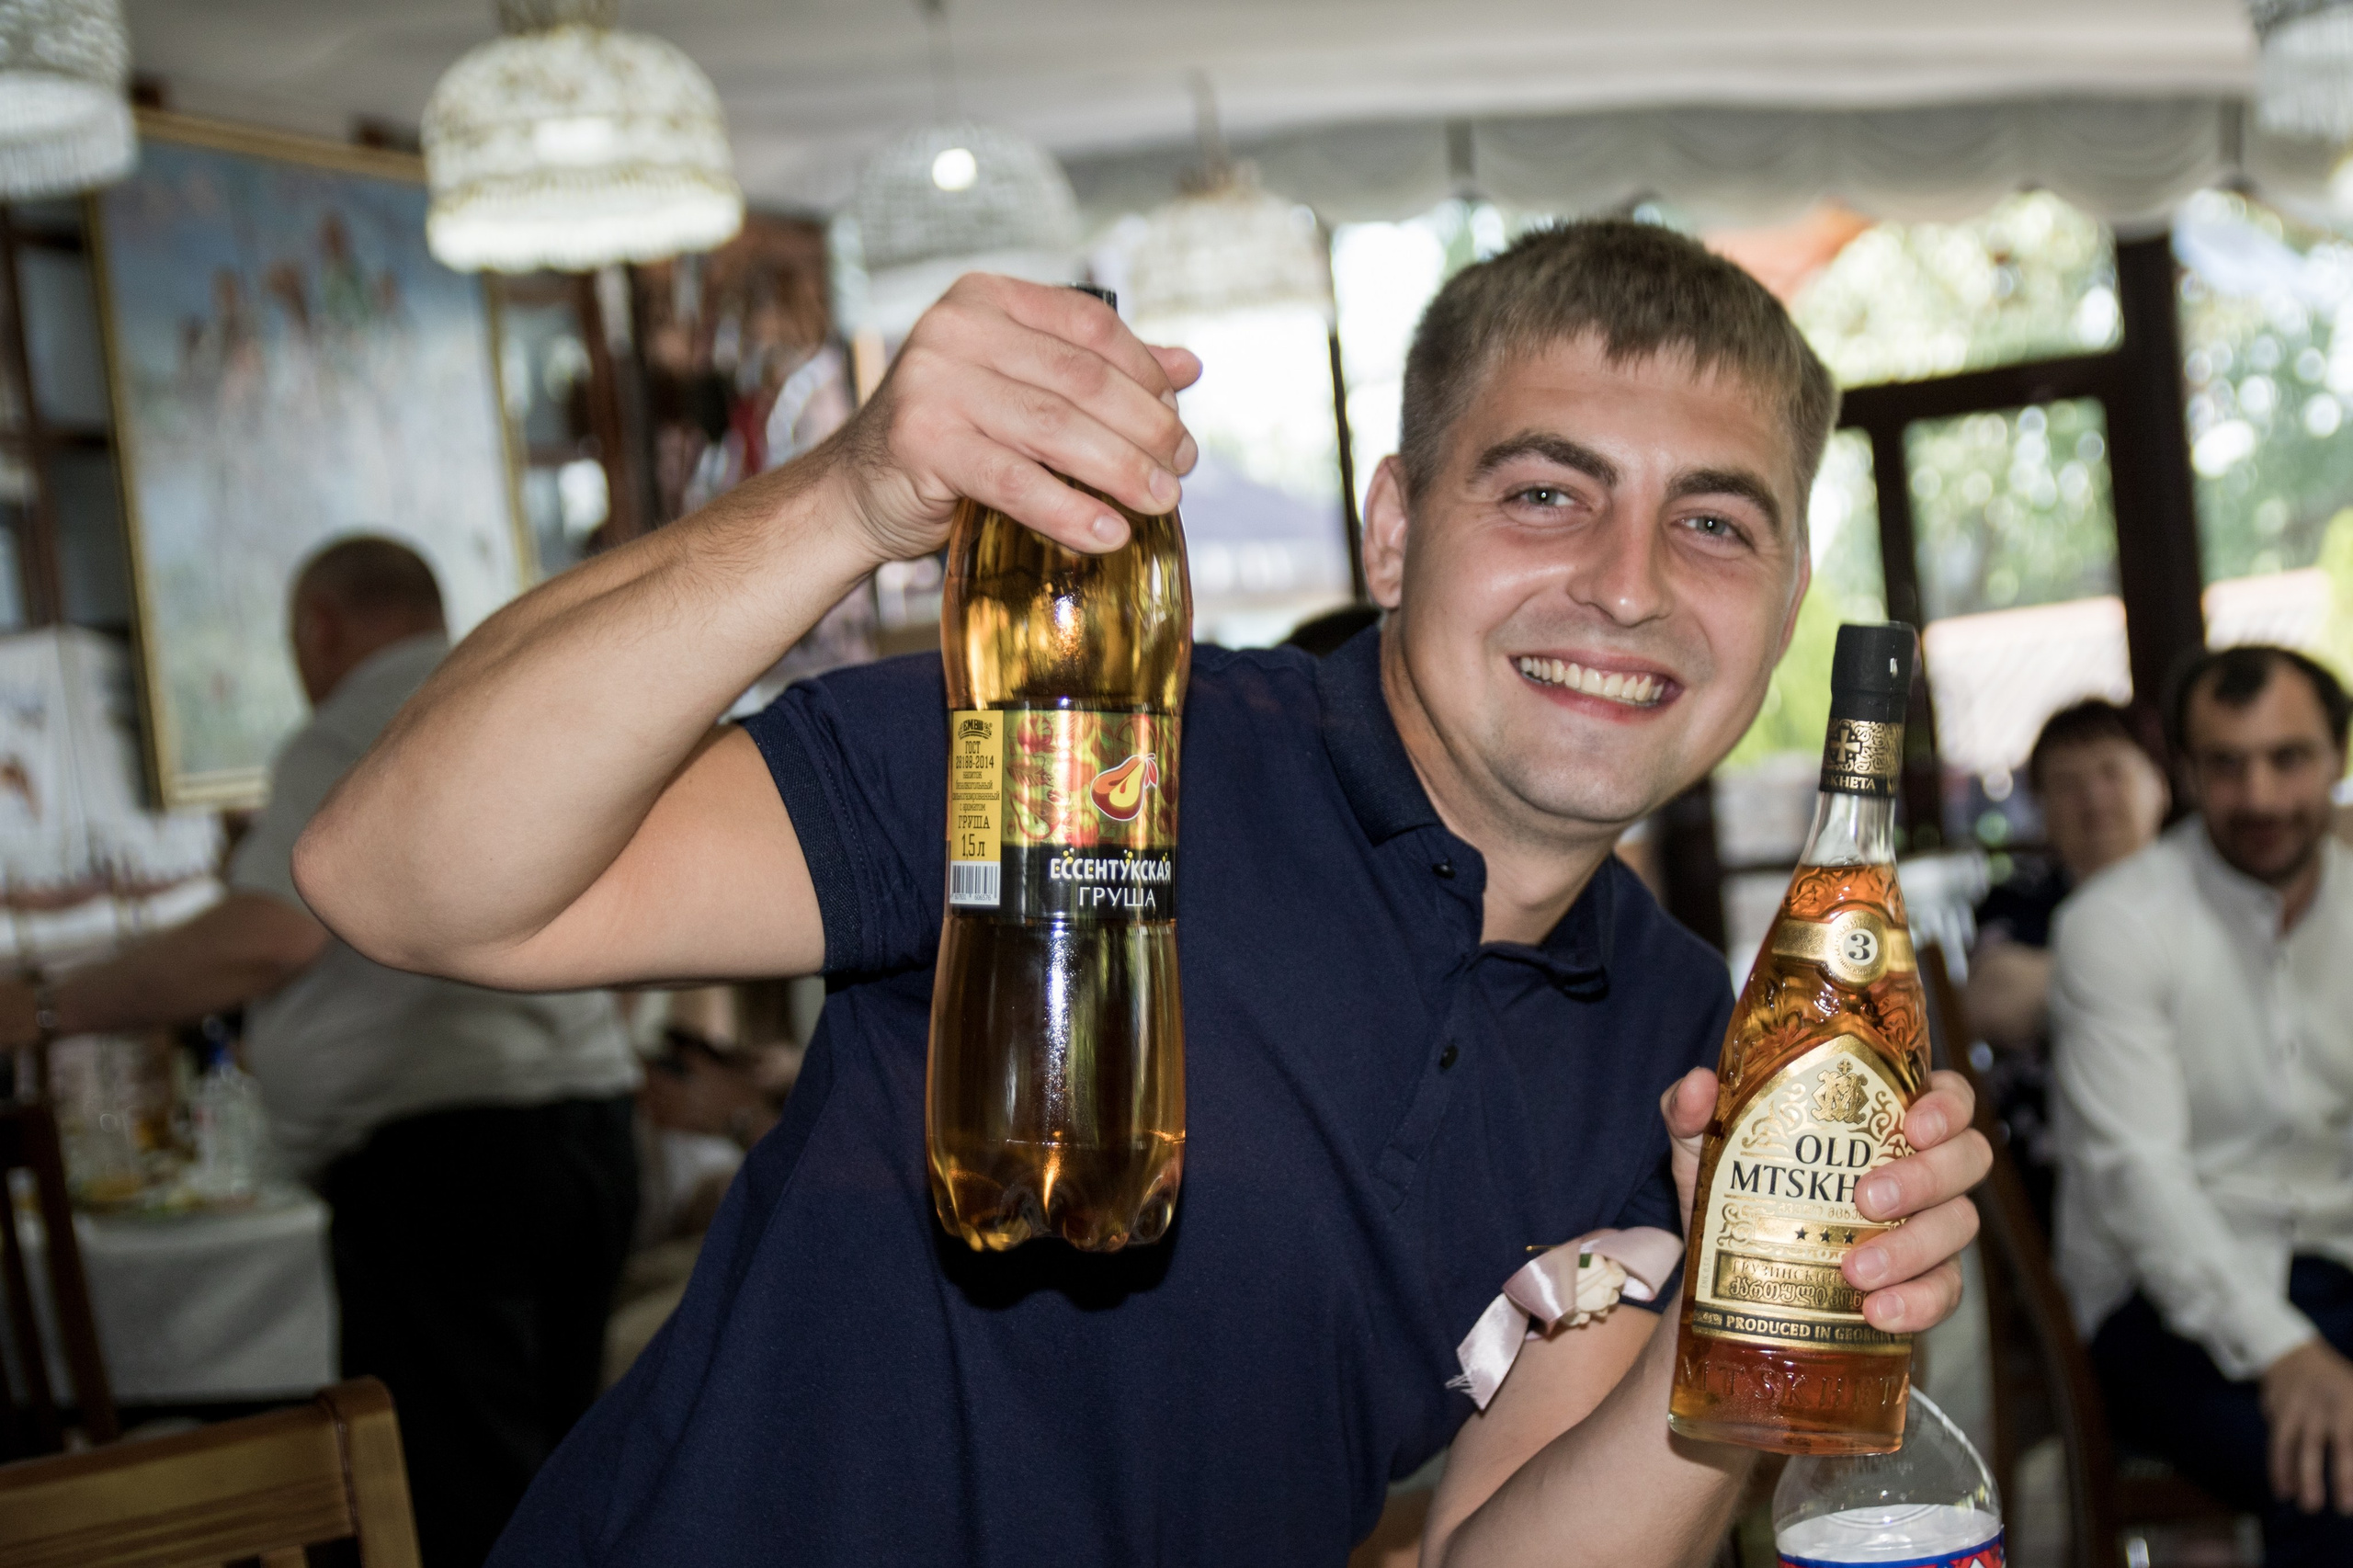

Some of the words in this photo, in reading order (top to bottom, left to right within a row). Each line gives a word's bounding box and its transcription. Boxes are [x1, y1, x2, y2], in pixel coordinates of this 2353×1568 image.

[965, 741, 981, 754] ГОСТ
[958, 814, 991, 829] ГРУША
[961, 833, 975, 859] 1,5
[977, 841, 985, 857] л
[1050, 857, 1172, 881] ЕССЕНТУКСКАЯ
[1079, 886, 1156, 908] ГРУША
[1848, 933, 1870, 960] 3
[1795, 1134, 1872, 1168] OLD
[1730, 1160, 1861, 1203] MTSKH
[1725, 1314, 1811, 1337] PRODUCED
[1814, 1324, 1831, 1339] IN
